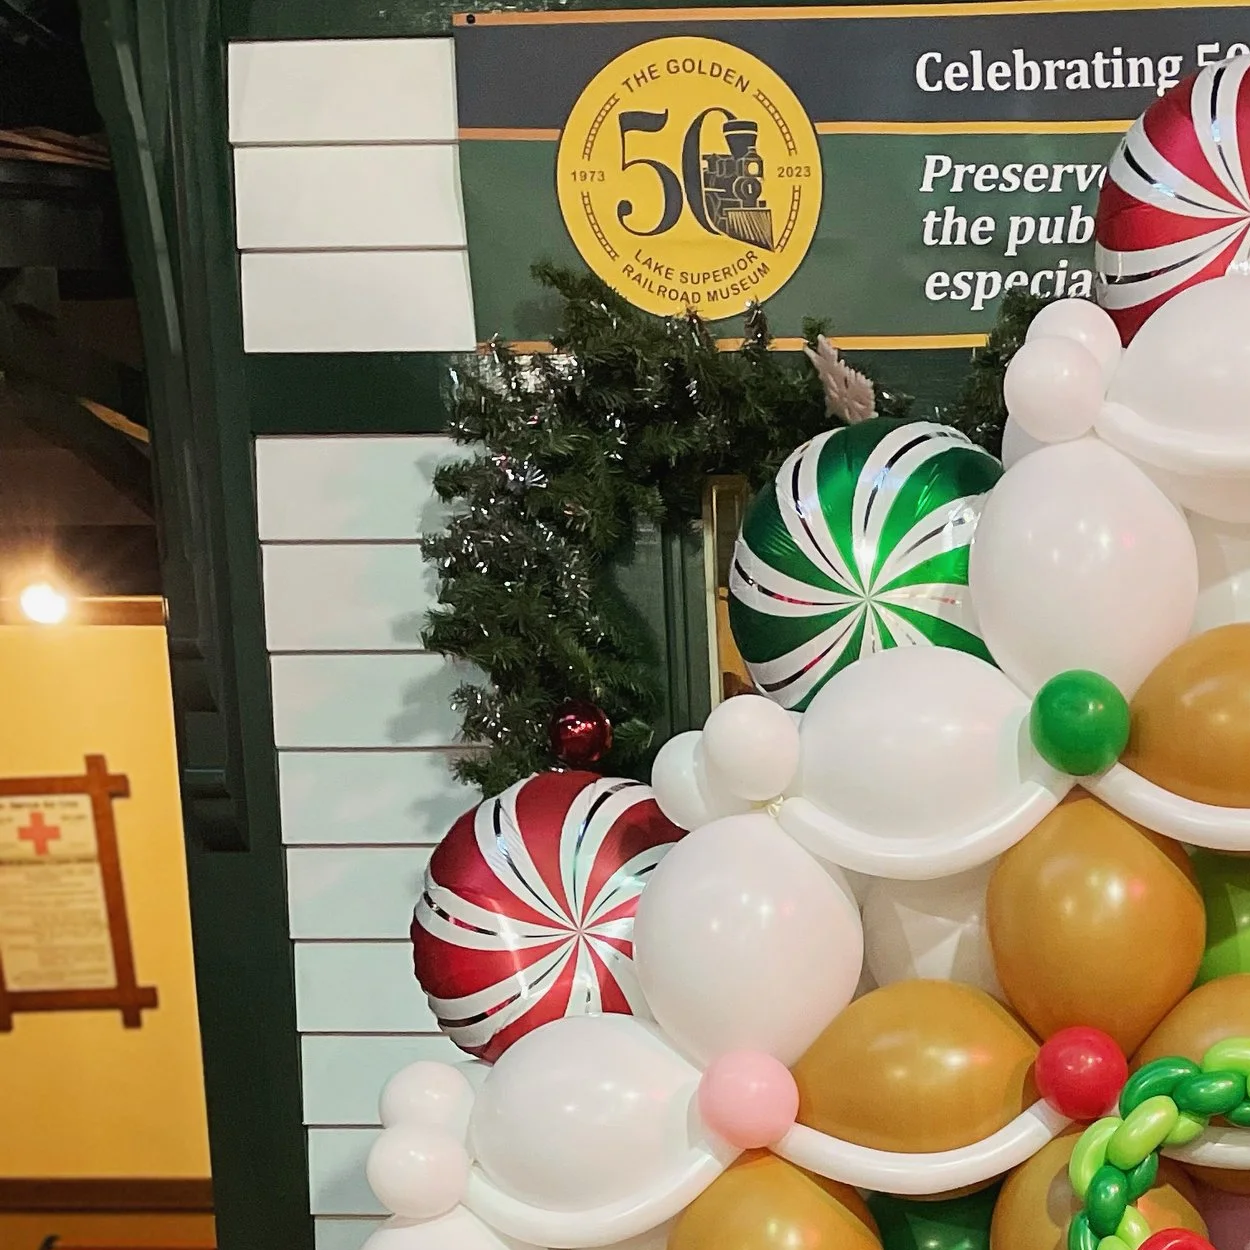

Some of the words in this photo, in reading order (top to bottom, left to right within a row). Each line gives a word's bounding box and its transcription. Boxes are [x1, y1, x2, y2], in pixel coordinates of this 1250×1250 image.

[621, 64, 661, 93] THE
[666, 58, 751, 93] GOLDEN
[915, 46, 1184, 97] Celebrating
[570, 170, 606, 182] 1973
[777, 166, 812, 178] 2023
[919, 154, 1107, 193] Preserv
[922, 205, 996, 246] the
[622, 263, 702, 304] RAILROAD
[706, 262, 771, 302] MUSEUM
[634, 248, 675, 280] LAKE
[679, 249, 759, 285] SUPERIOR
